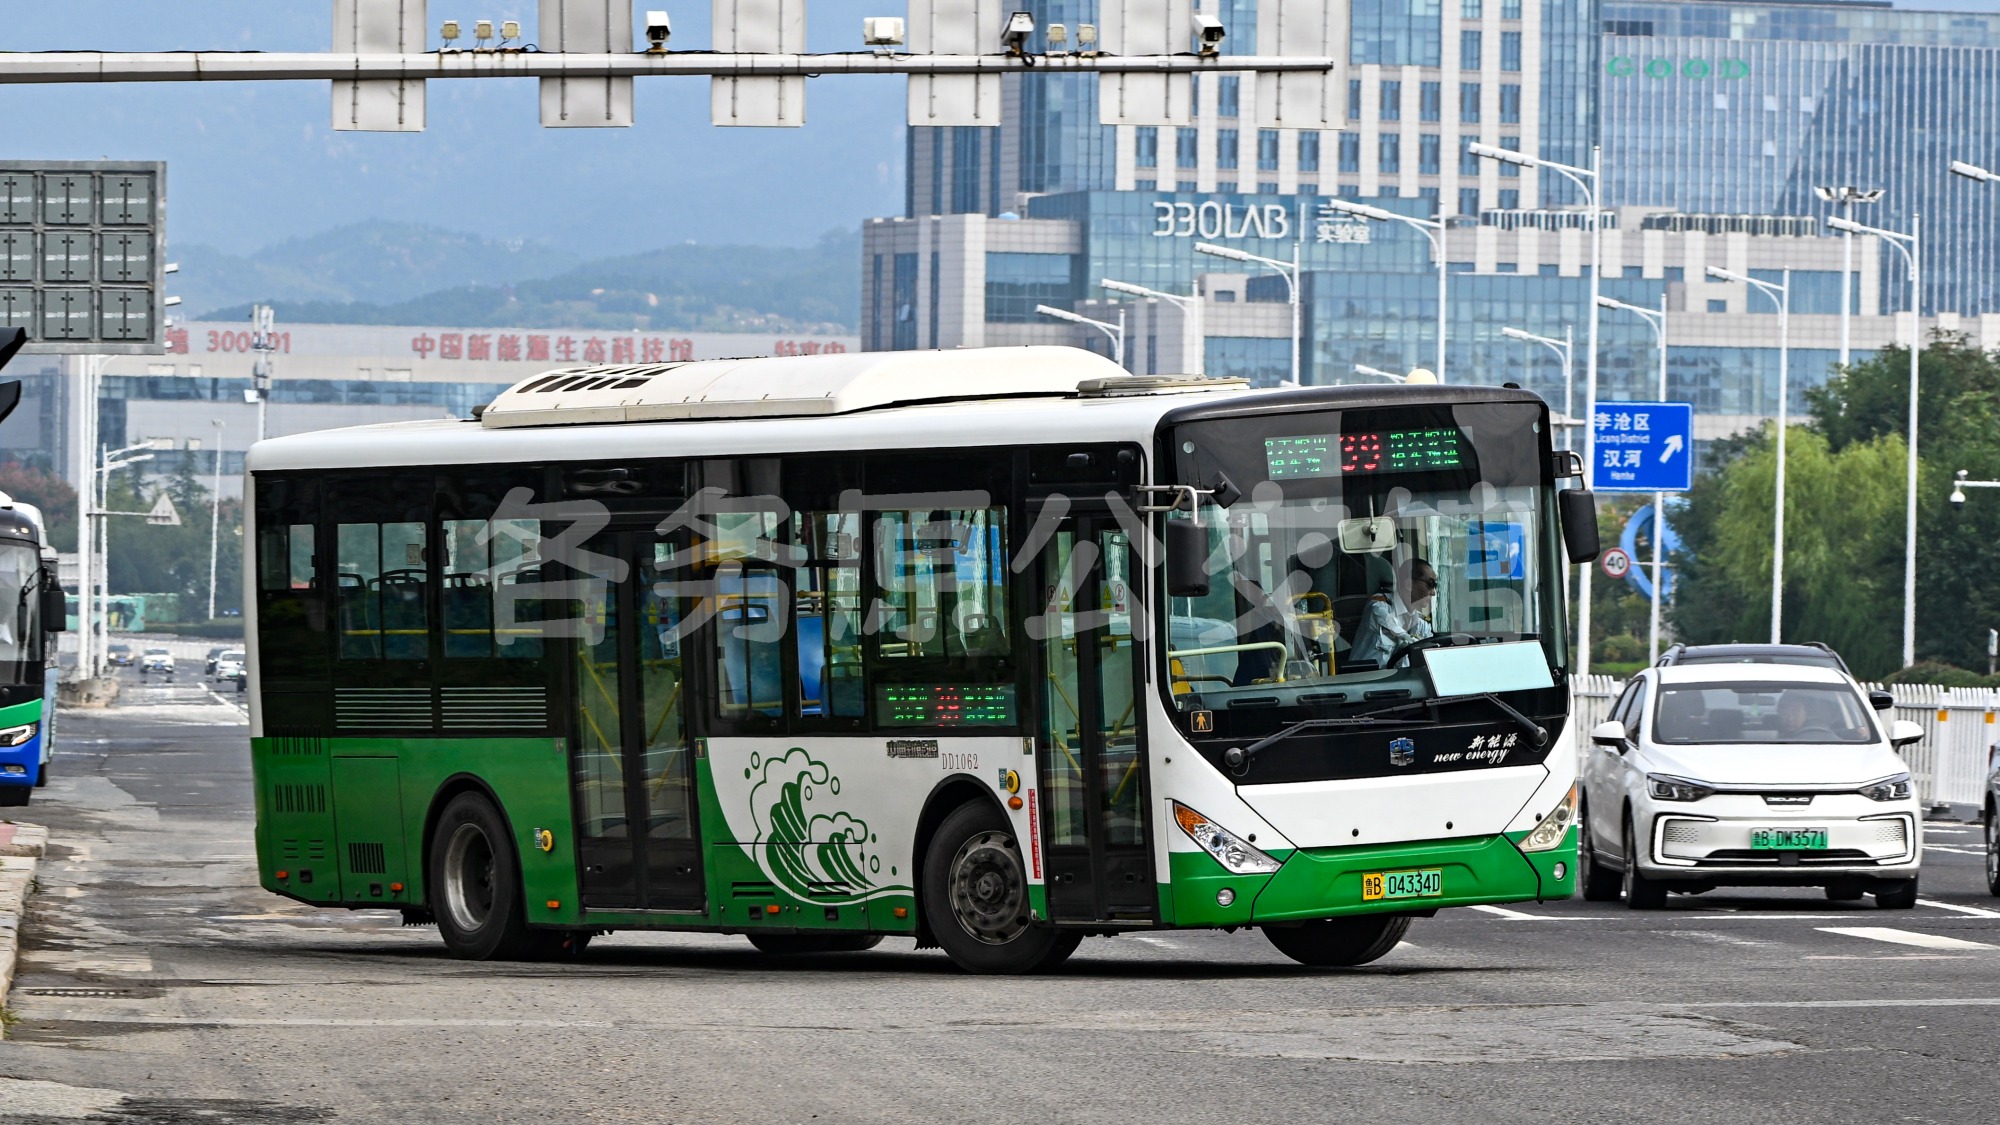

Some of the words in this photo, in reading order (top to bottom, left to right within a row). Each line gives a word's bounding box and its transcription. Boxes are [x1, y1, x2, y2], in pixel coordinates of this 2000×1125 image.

[1606, 56, 1750, 80] GOOD
[1317, 223, 1370, 244] 实验室
[207, 330, 291, 353] 30001
[411, 333, 694, 364] 中国新能源生态科技馆
[1594, 412, 1650, 431] 李沧区
[1603, 449, 1642, 468] 汉河
[1607, 556, 1625, 570] 40
[1467, 732, 1517, 749] 新能源
[942, 753, 978, 770] DD1062
[1433, 752, 1463, 763] new
[1465, 748, 1510, 765] energy
